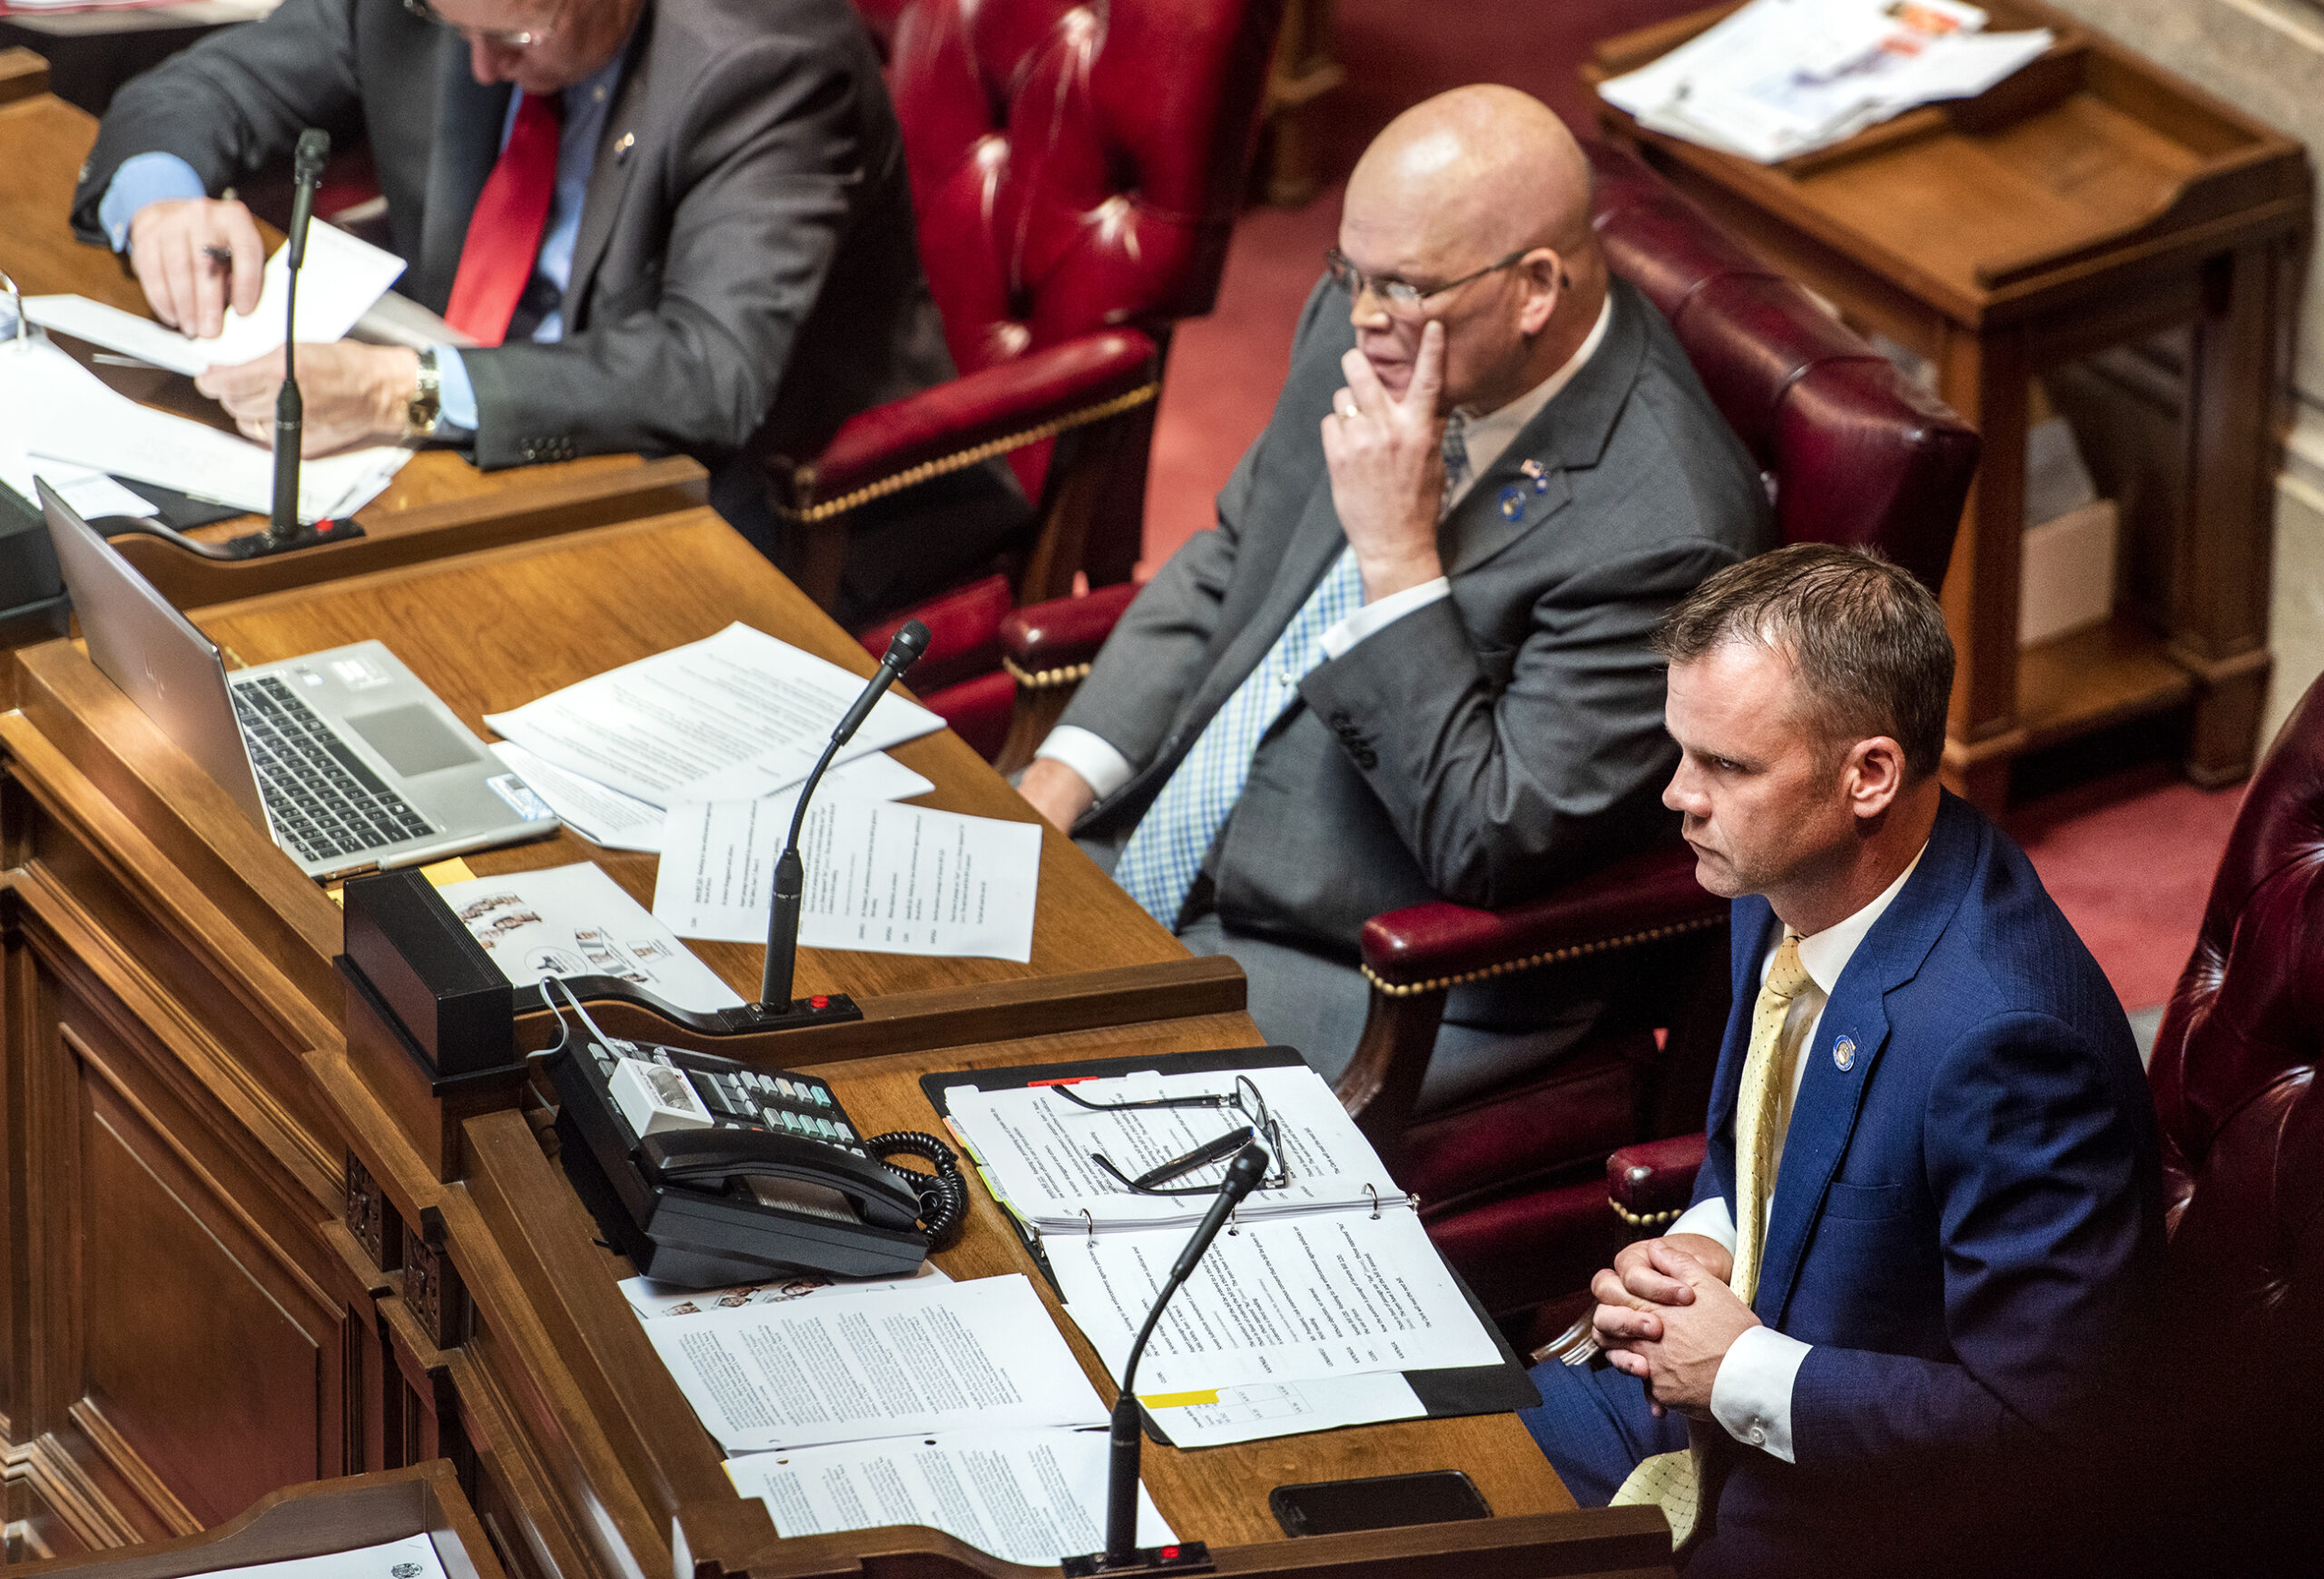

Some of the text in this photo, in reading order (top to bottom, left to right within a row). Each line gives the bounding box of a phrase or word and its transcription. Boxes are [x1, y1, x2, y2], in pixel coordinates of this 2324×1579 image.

[1295, 1231, 1307, 1245] policies
[1342, 1230, 1354, 1247] opposed
[1304, 1246, 1315, 1258] agency
[1352, 1248, 1361, 1258] those
[1210, 1259, 1222, 1273] reading
[1221, 1260, 1229, 1269] have
[1267, 1266, 1275, 1275] that
[1311, 1259, 1327, 1282] enforcement
[1218, 1274, 1226, 1283] third
[1102, 1280, 1118, 1305] enforcement
